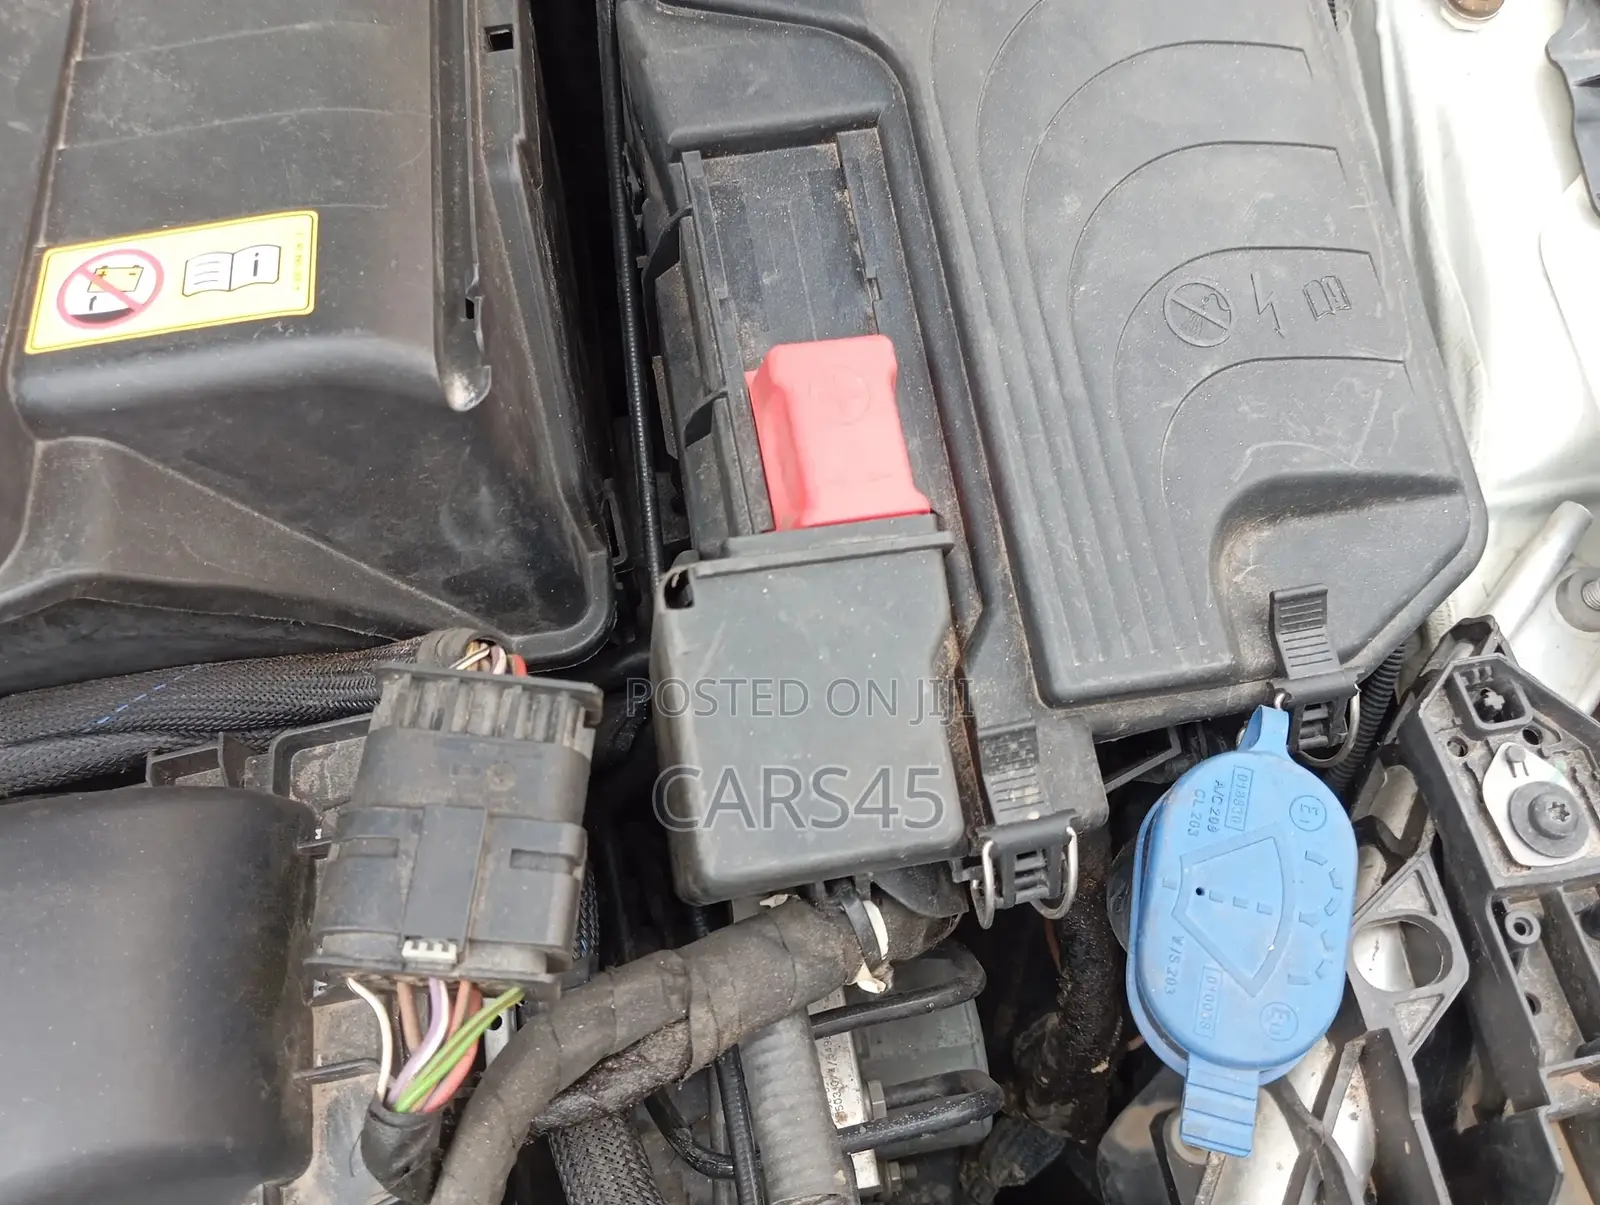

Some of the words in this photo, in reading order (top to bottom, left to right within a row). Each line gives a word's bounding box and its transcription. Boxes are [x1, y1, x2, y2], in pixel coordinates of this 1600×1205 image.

[1192, 789, 1206, 807] CL
[1211, 779, 1226, 804] A/C
[1187, 808, 1203, 837] 203
